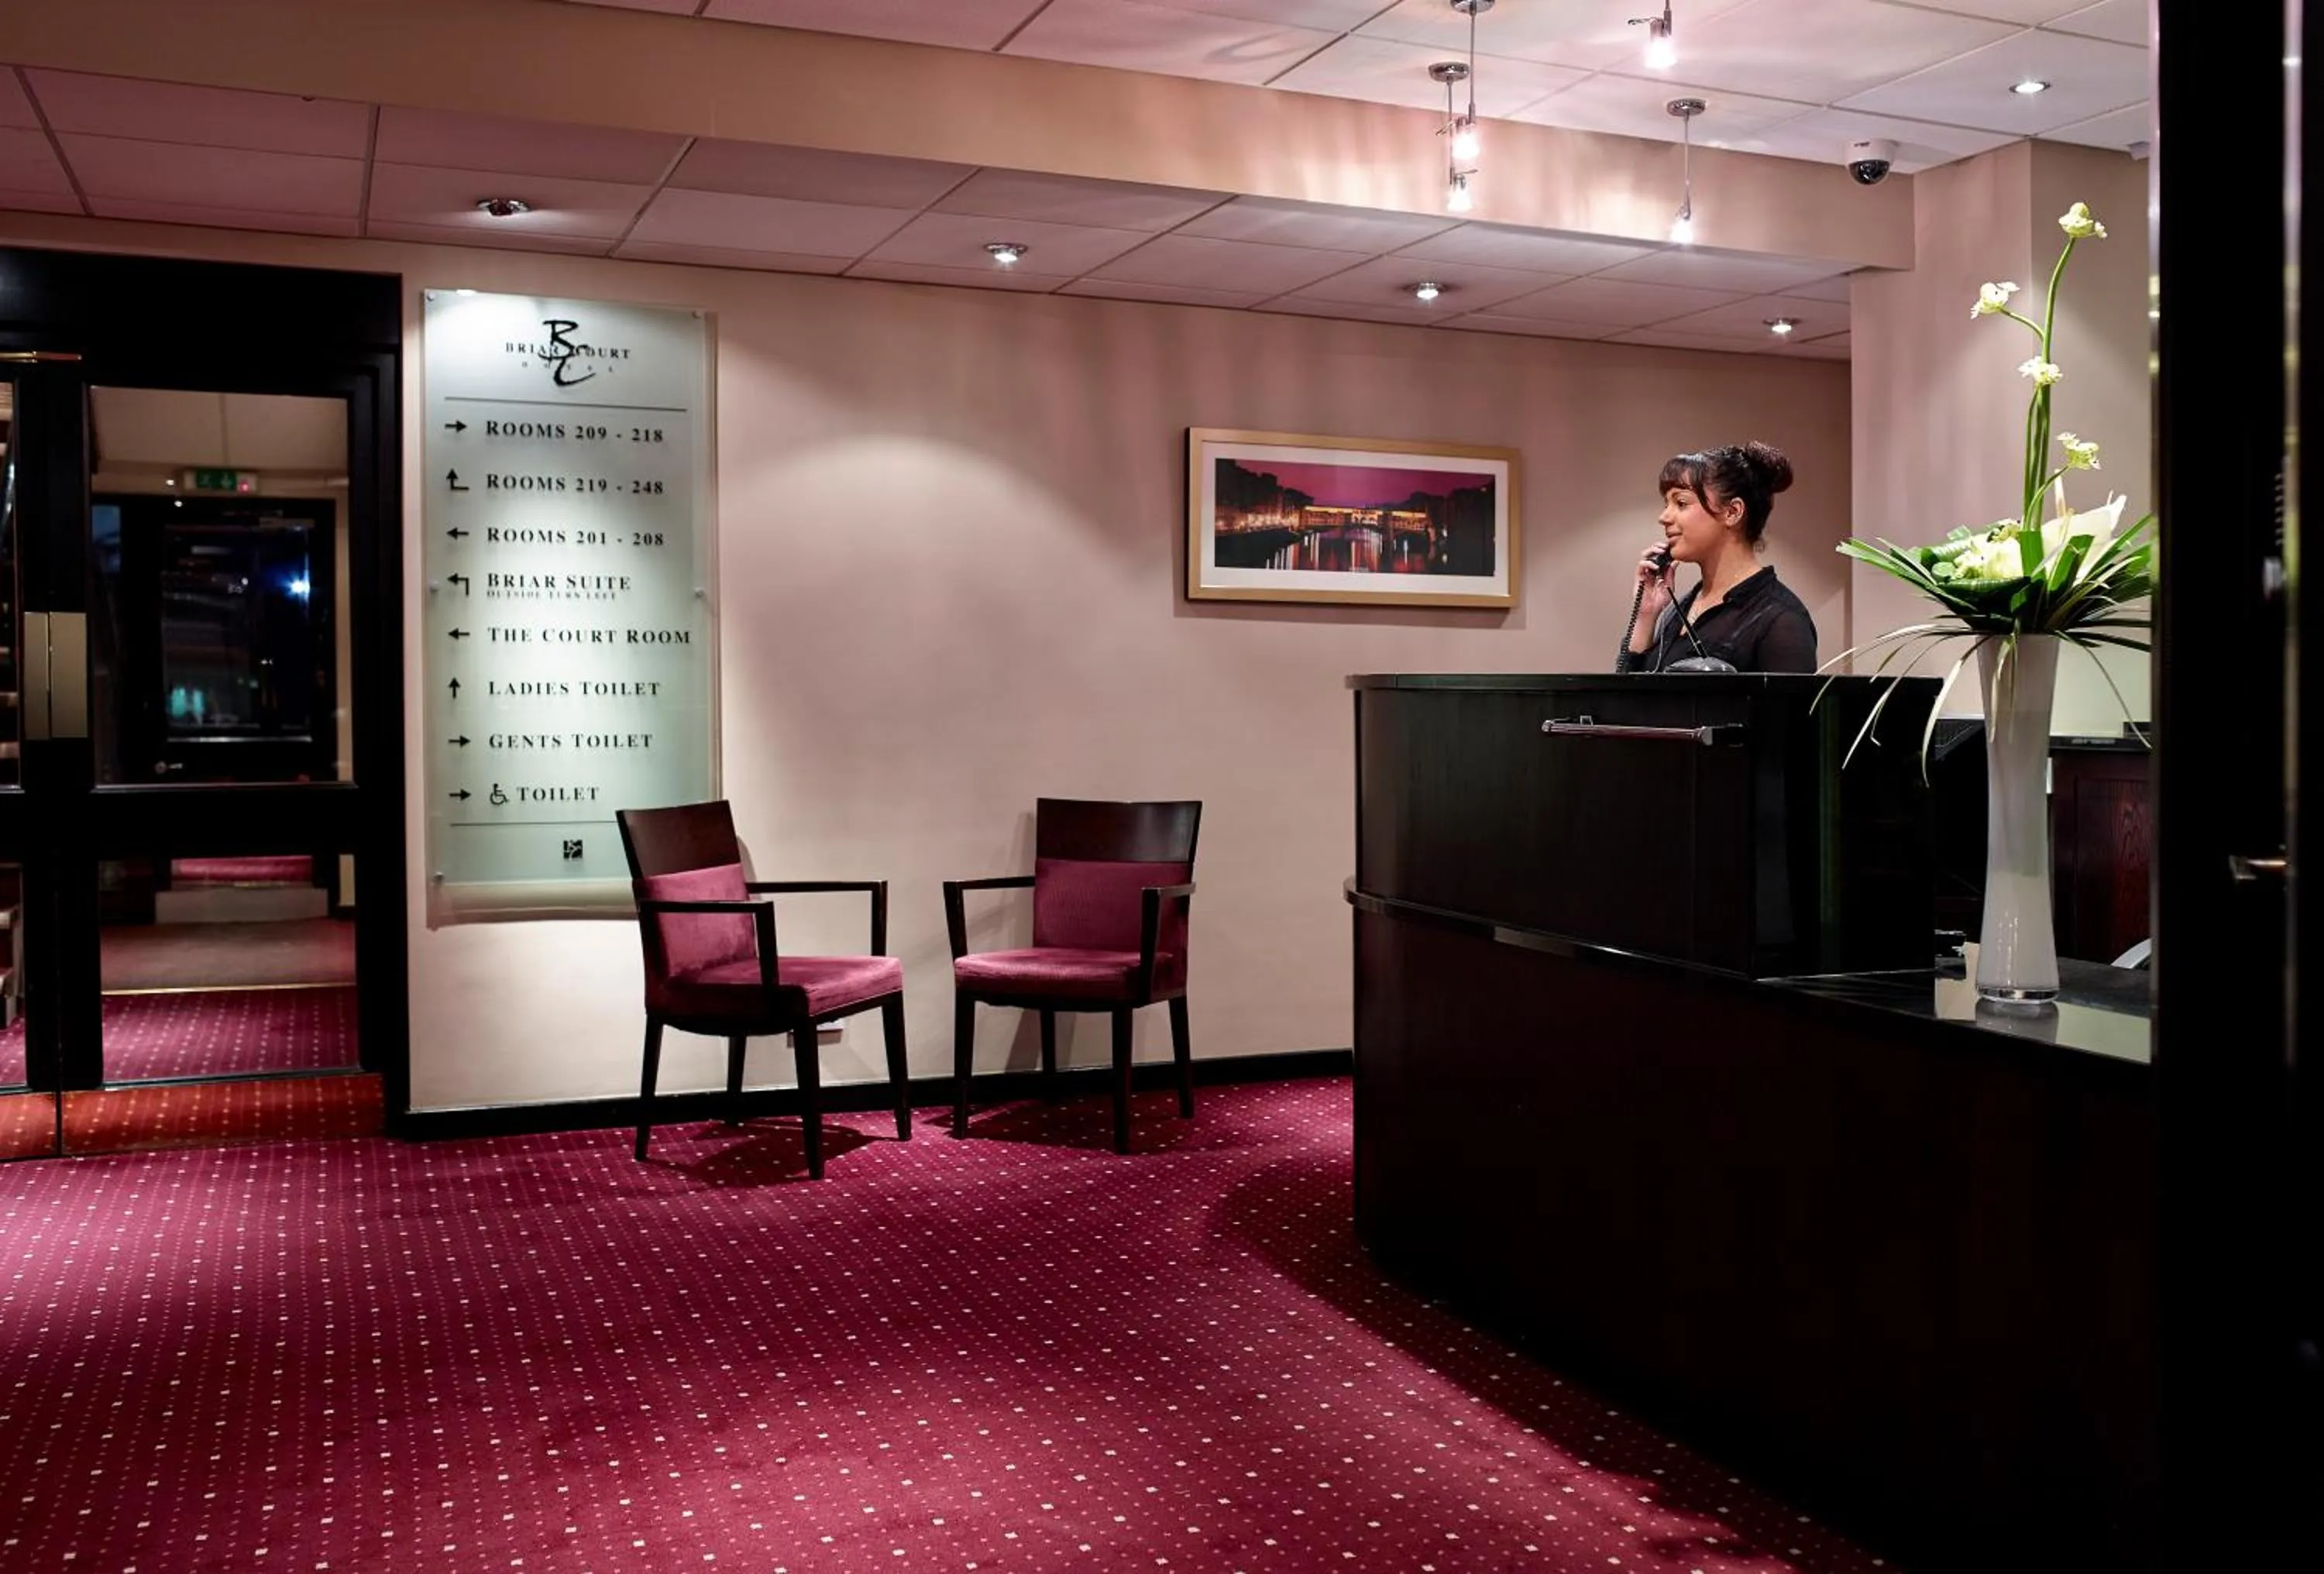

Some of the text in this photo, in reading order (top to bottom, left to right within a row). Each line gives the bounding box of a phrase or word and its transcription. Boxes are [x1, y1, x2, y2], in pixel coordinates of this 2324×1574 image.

[505, 342, 560, 356] BRIAR
[486, 420, 566, 440] ROOMS
[574, 424, 607, 441] 209
[631, 427, 664, 444] 218
[486, 473, 566, 493] ROOMS
[575, 477, 608, 494] 219
[631, 479, 664, 496] 248
[486, 526, 566, 546] ROOMS
[576, 530, 607, 547] 201
[632, 531, 665, 548] 208
[486, 572, 631, 590] BRIAR SUITE
[486, 627, 691, 646] THE COURT ROOM
[488, 680, 662, 698] LADIES TOILET
[488, 733, 654, 751] GENTS TOILET
[515, 785, 600, 802] TOILET
